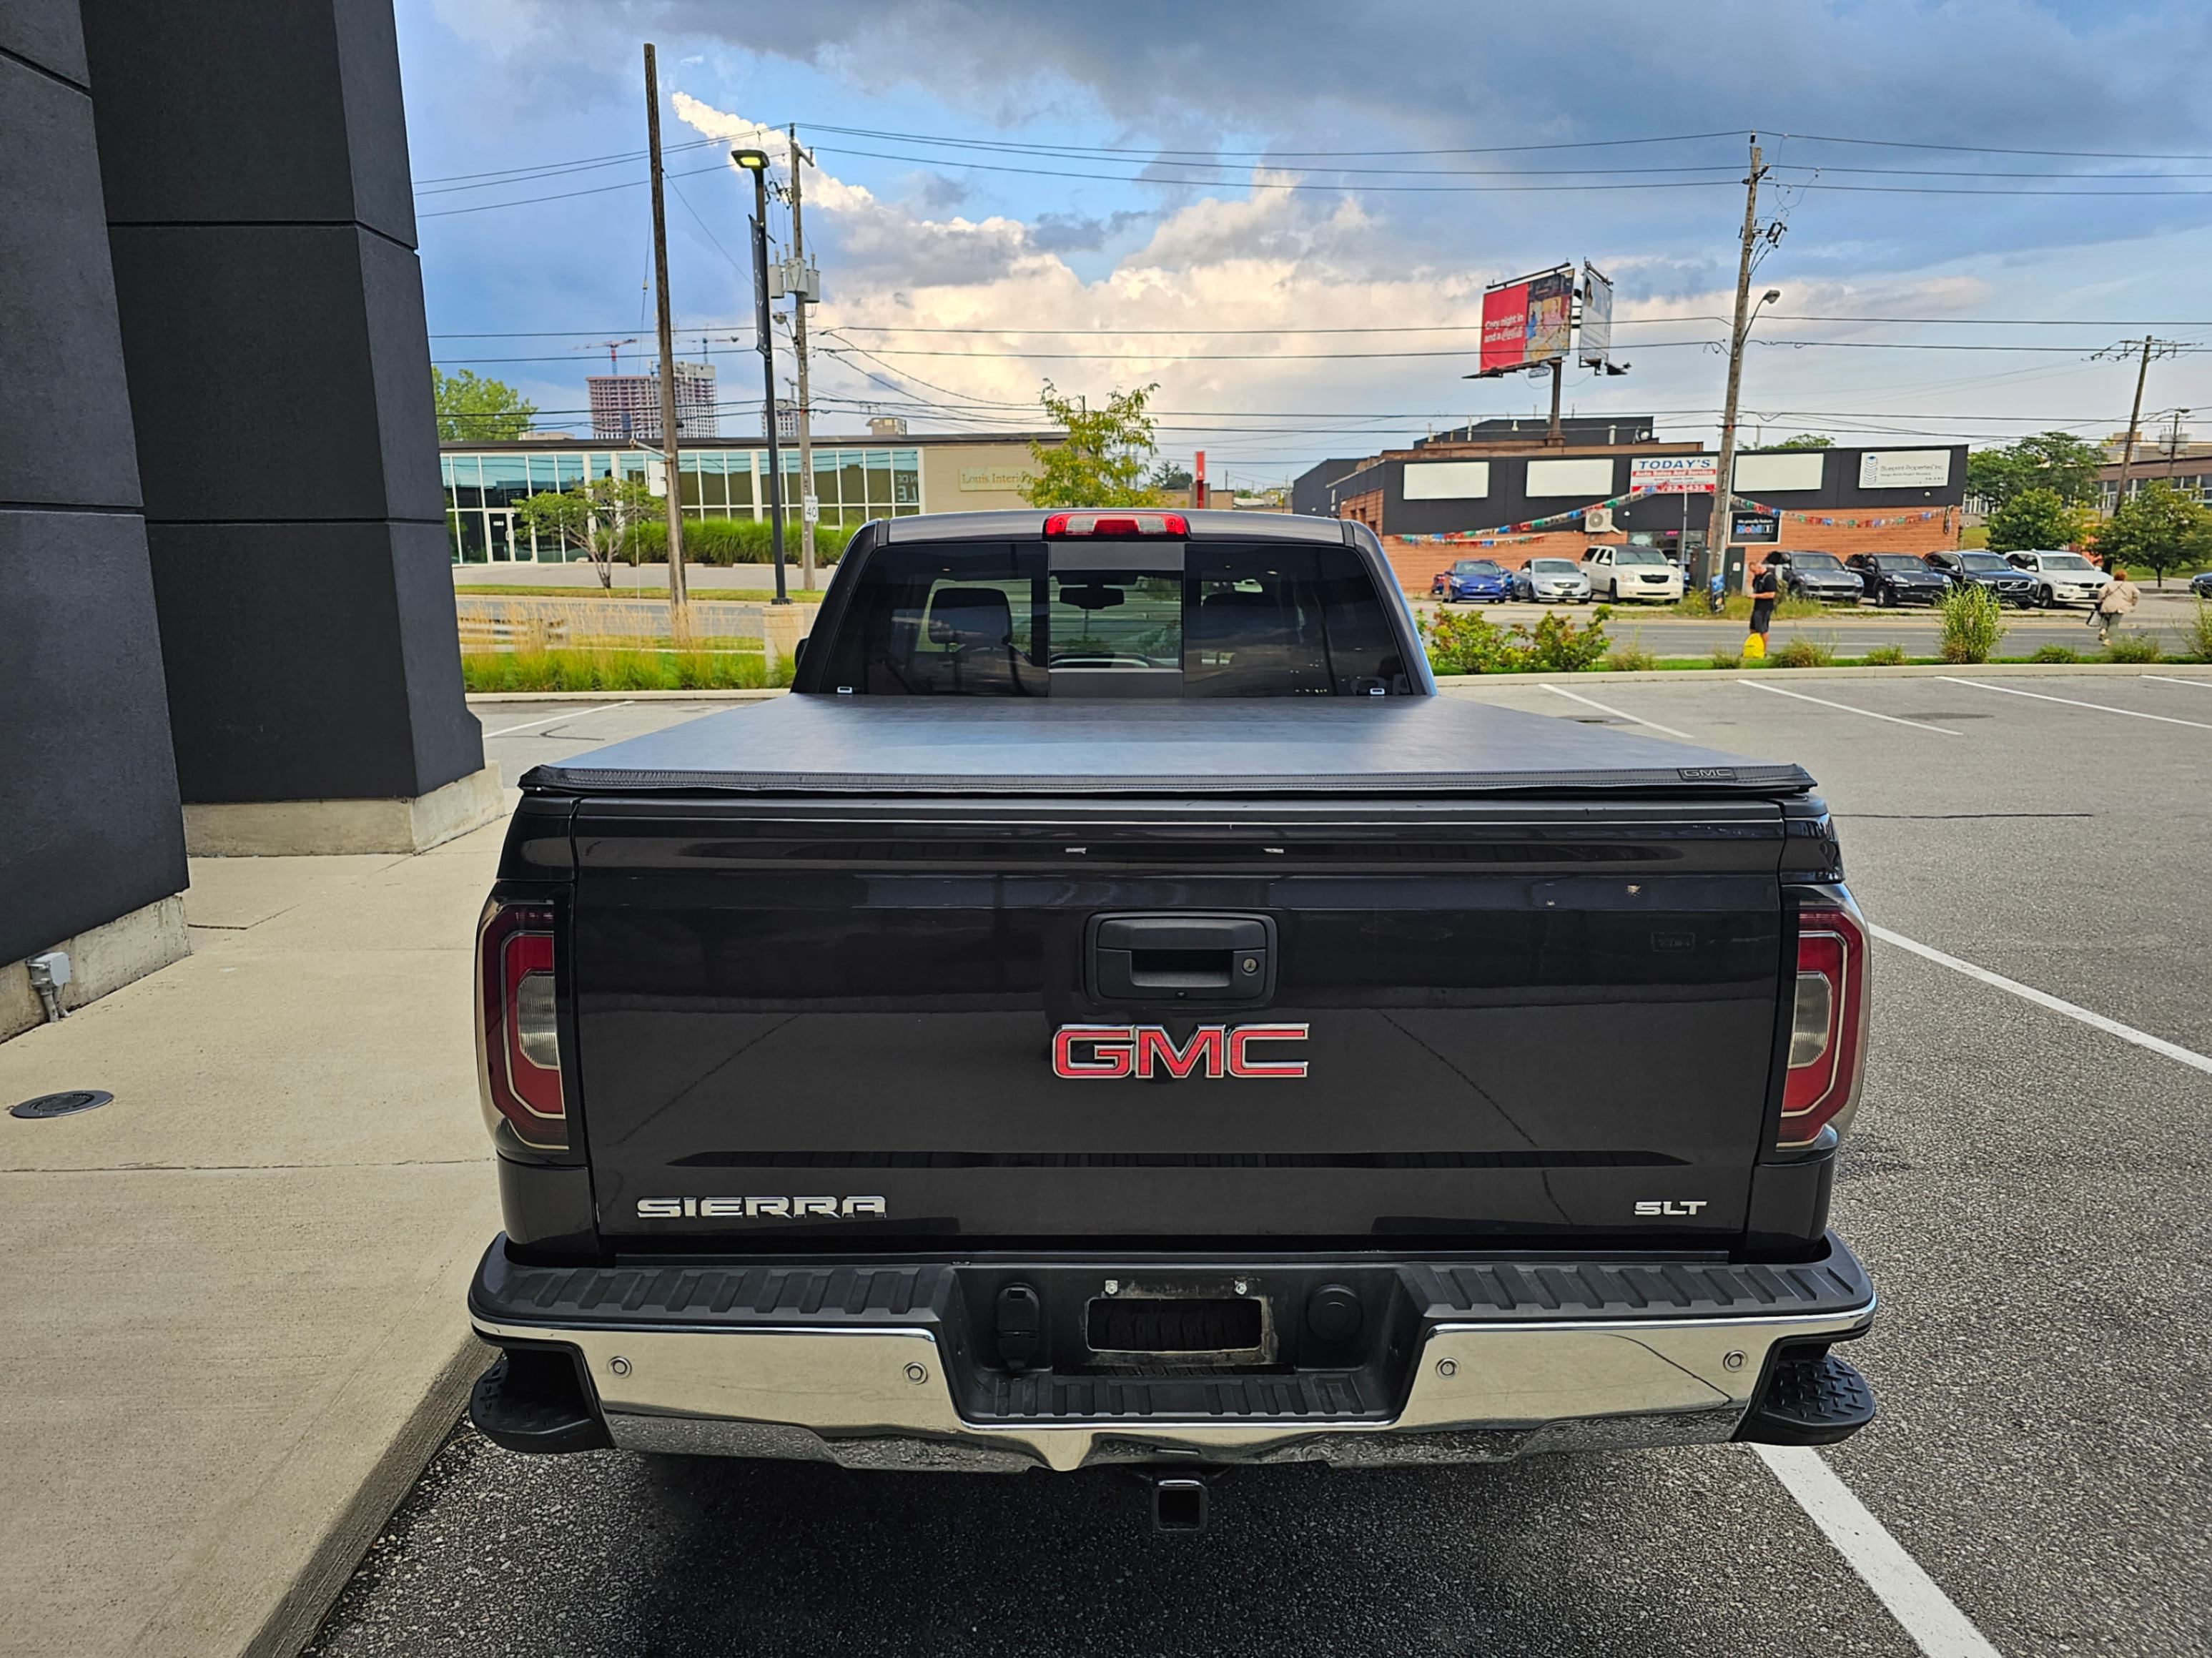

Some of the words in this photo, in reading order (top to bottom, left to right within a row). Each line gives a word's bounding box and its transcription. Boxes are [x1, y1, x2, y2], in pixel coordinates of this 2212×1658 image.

[1639, 459, 1711, 469] TODAY'S
[962, 474, 989, 484] Louis
[992, 473, 1030, 484] Interi
[806, 507, 816, 517] 40
[1736, 524, 1762, 534] Mobil
[1052, 1023, 1309, 1079] GMC
[637, 1196, 887, 1218] SIERRA
[1634, 1201, 1707, 1215] SLT
